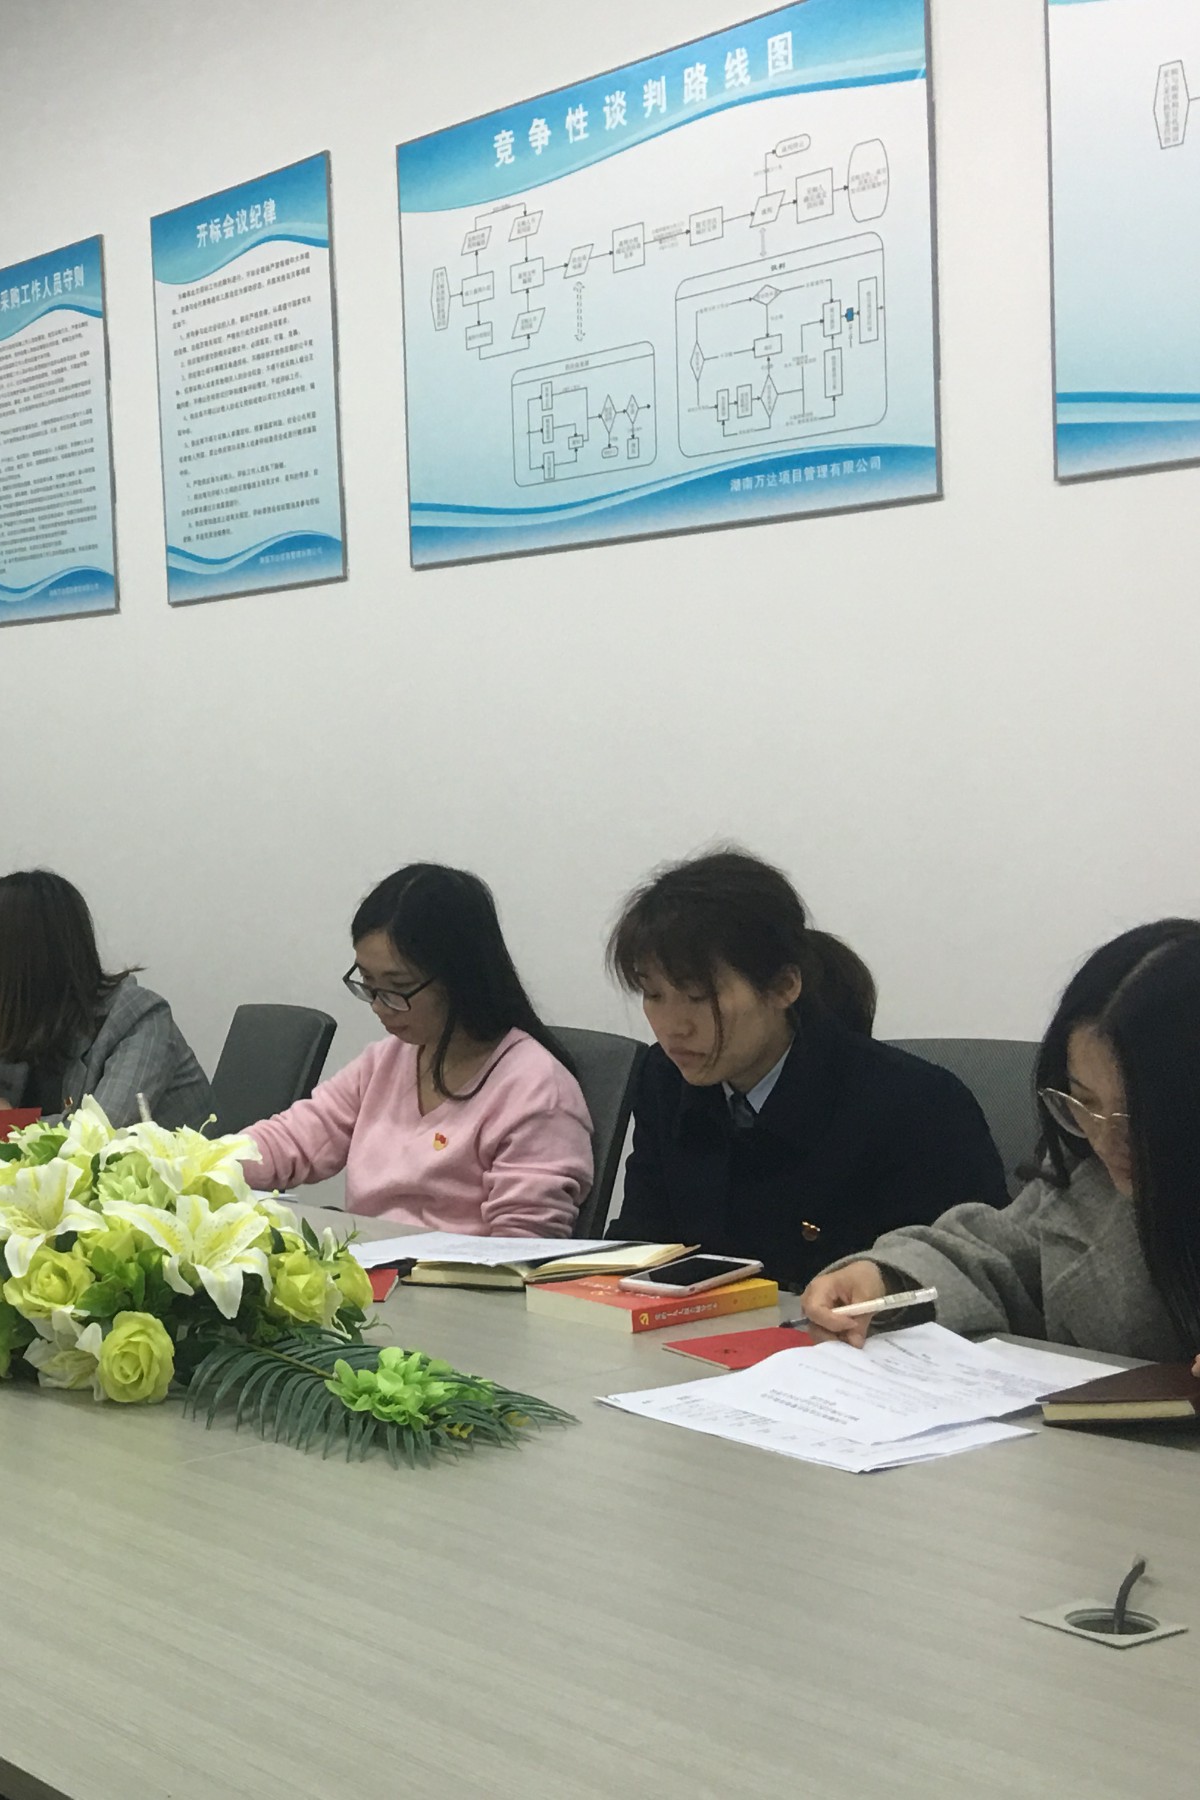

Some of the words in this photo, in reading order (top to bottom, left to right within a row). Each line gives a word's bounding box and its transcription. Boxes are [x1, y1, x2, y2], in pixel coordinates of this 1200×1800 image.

[493, 31, 794, 168] 竞争性谈判路线图
[196, 197, 277, 248] 开标会议纪律
[730, 456, 882, 492] 湖南万达项目管理有限公司
